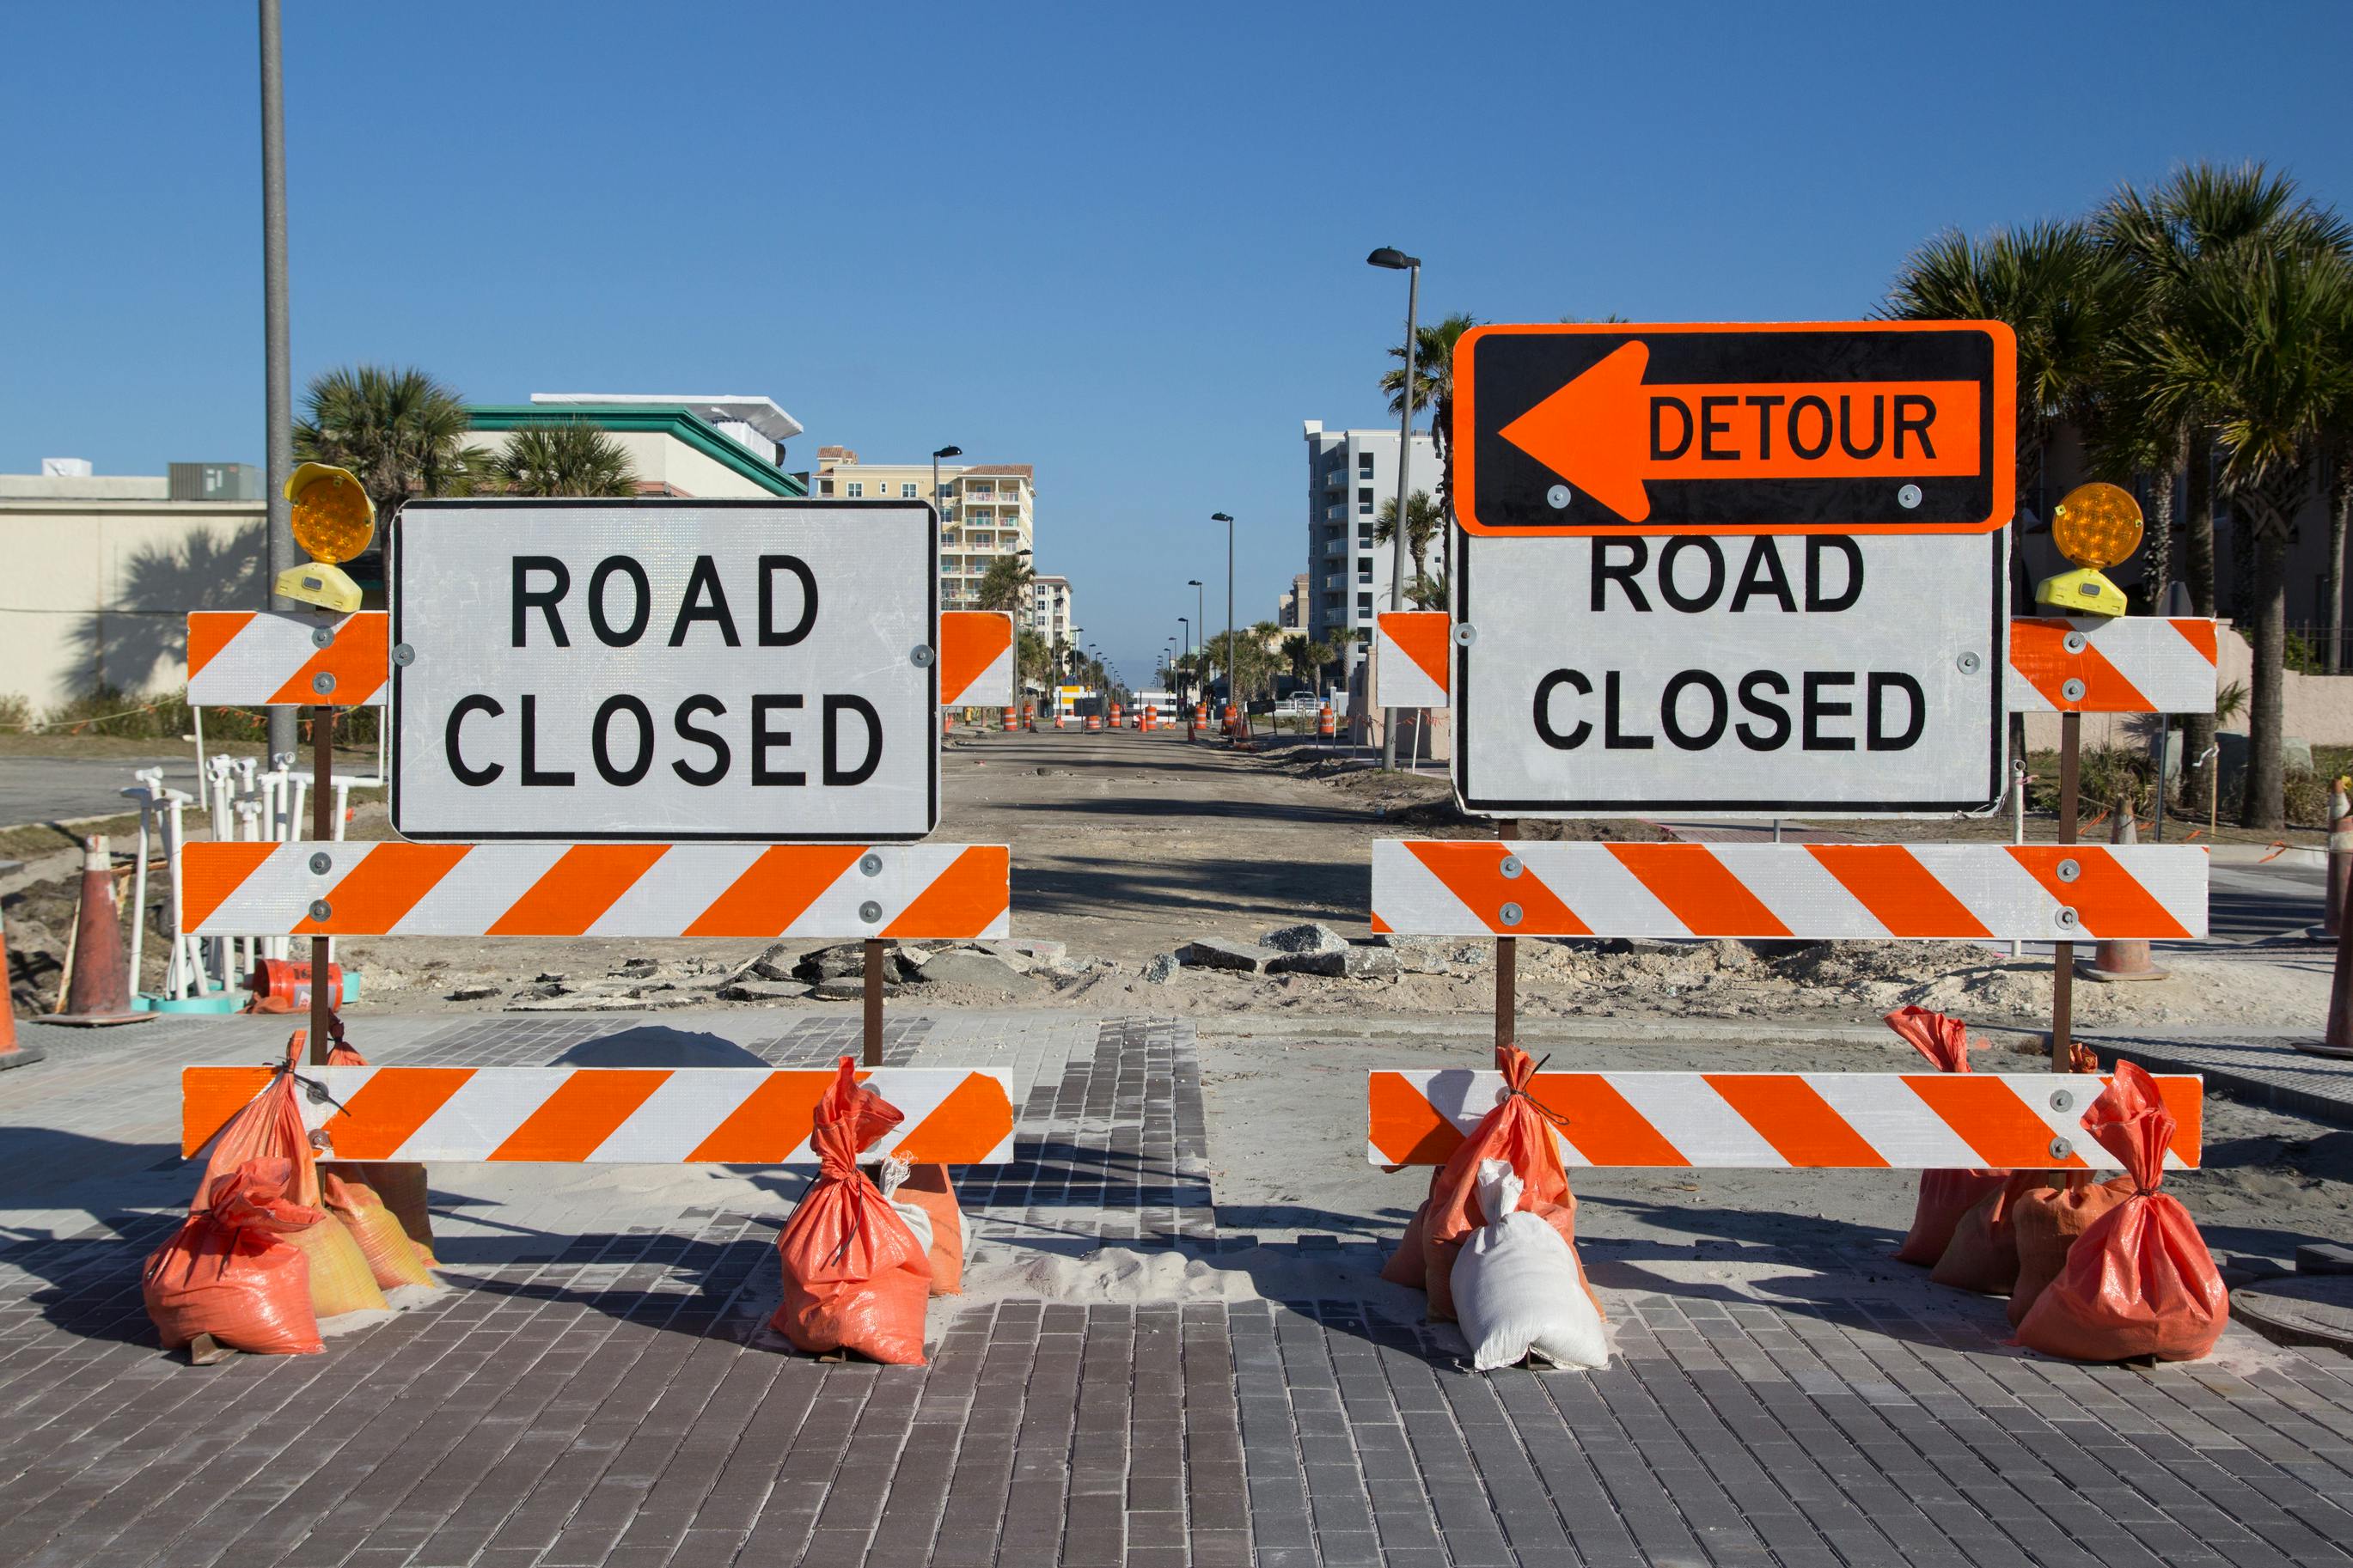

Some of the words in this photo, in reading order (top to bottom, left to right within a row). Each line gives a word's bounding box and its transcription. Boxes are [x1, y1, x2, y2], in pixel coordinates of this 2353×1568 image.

[1649, 394, 1937, 461] DETOUR
[511, 554, 819, 648] ROAD
[1591, 534, 1864, 613] ROAD
[445, 693, 883, 787] CLOSED
[1532, 668, 1926, 753] CLOSED
